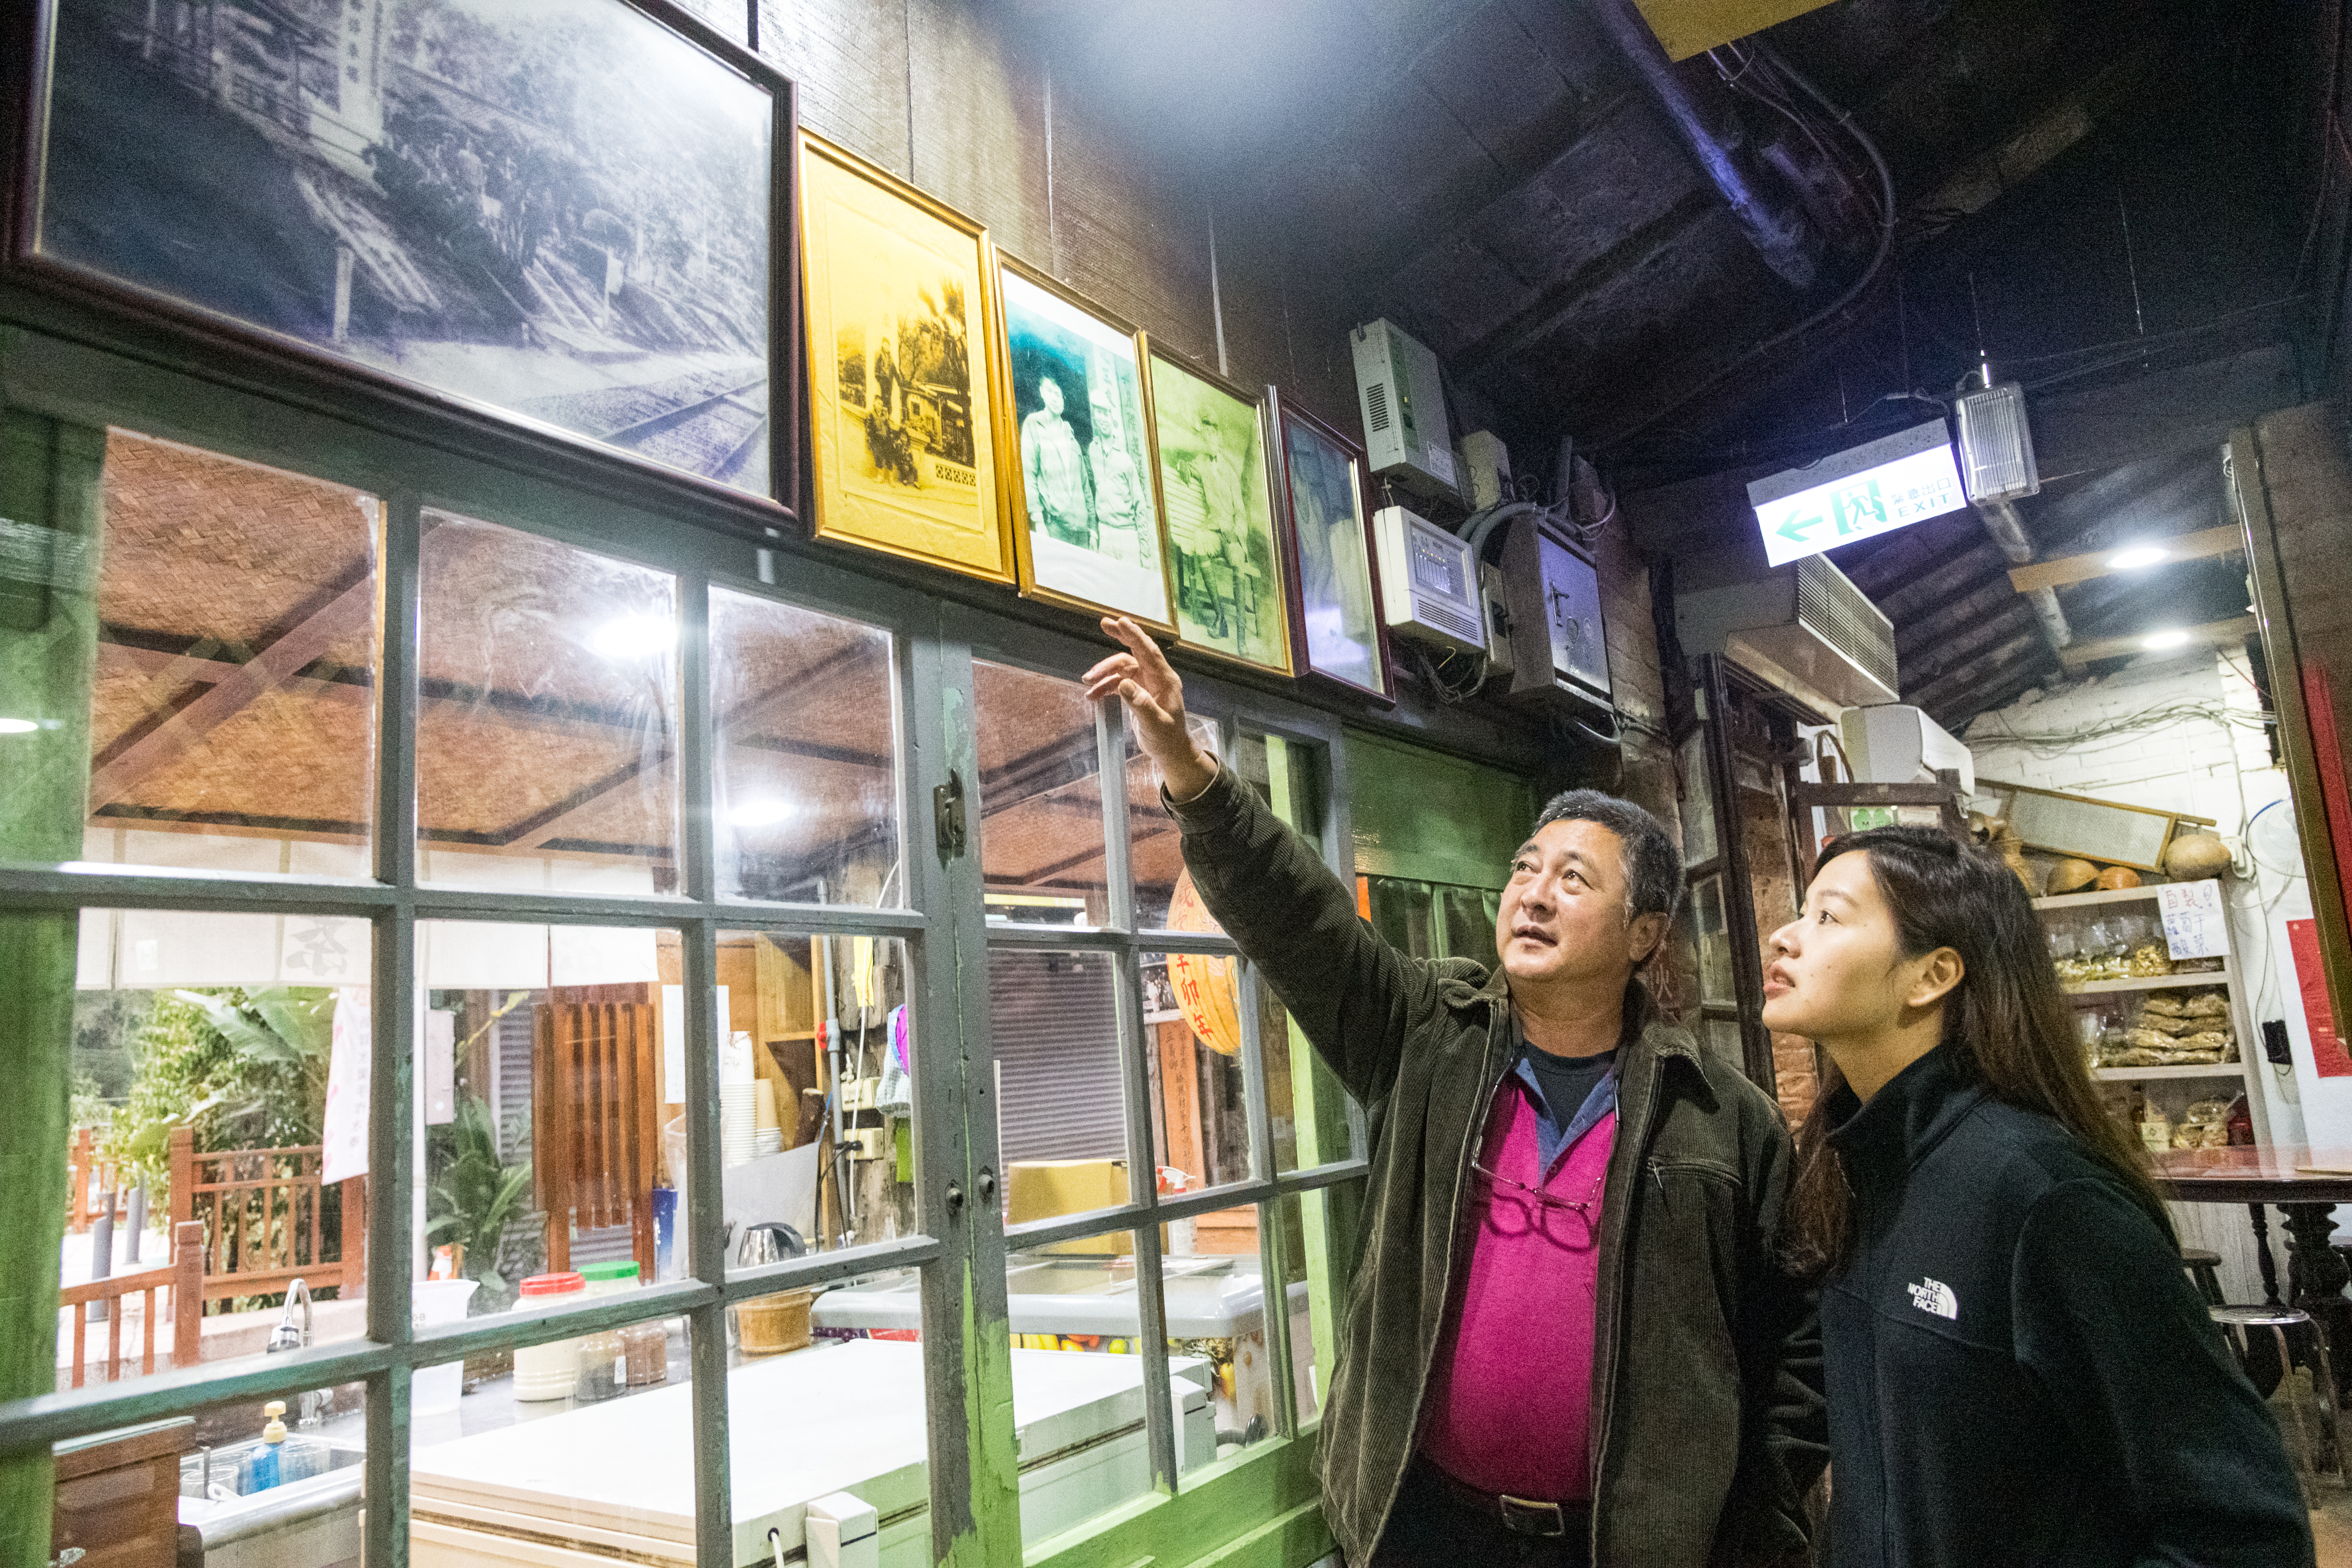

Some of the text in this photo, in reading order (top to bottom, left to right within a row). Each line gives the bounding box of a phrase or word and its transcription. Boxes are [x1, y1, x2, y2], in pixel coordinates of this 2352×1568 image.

[1891, 478, 1951, 504] 緊急出口
[1898, 493, 1949, 517] EXIT
[1908, 1282, 1939, 1303] NORTH
[1924, 1277, 1941, 1293] THE
[1914, 1296, 1938, 1313] FACE
